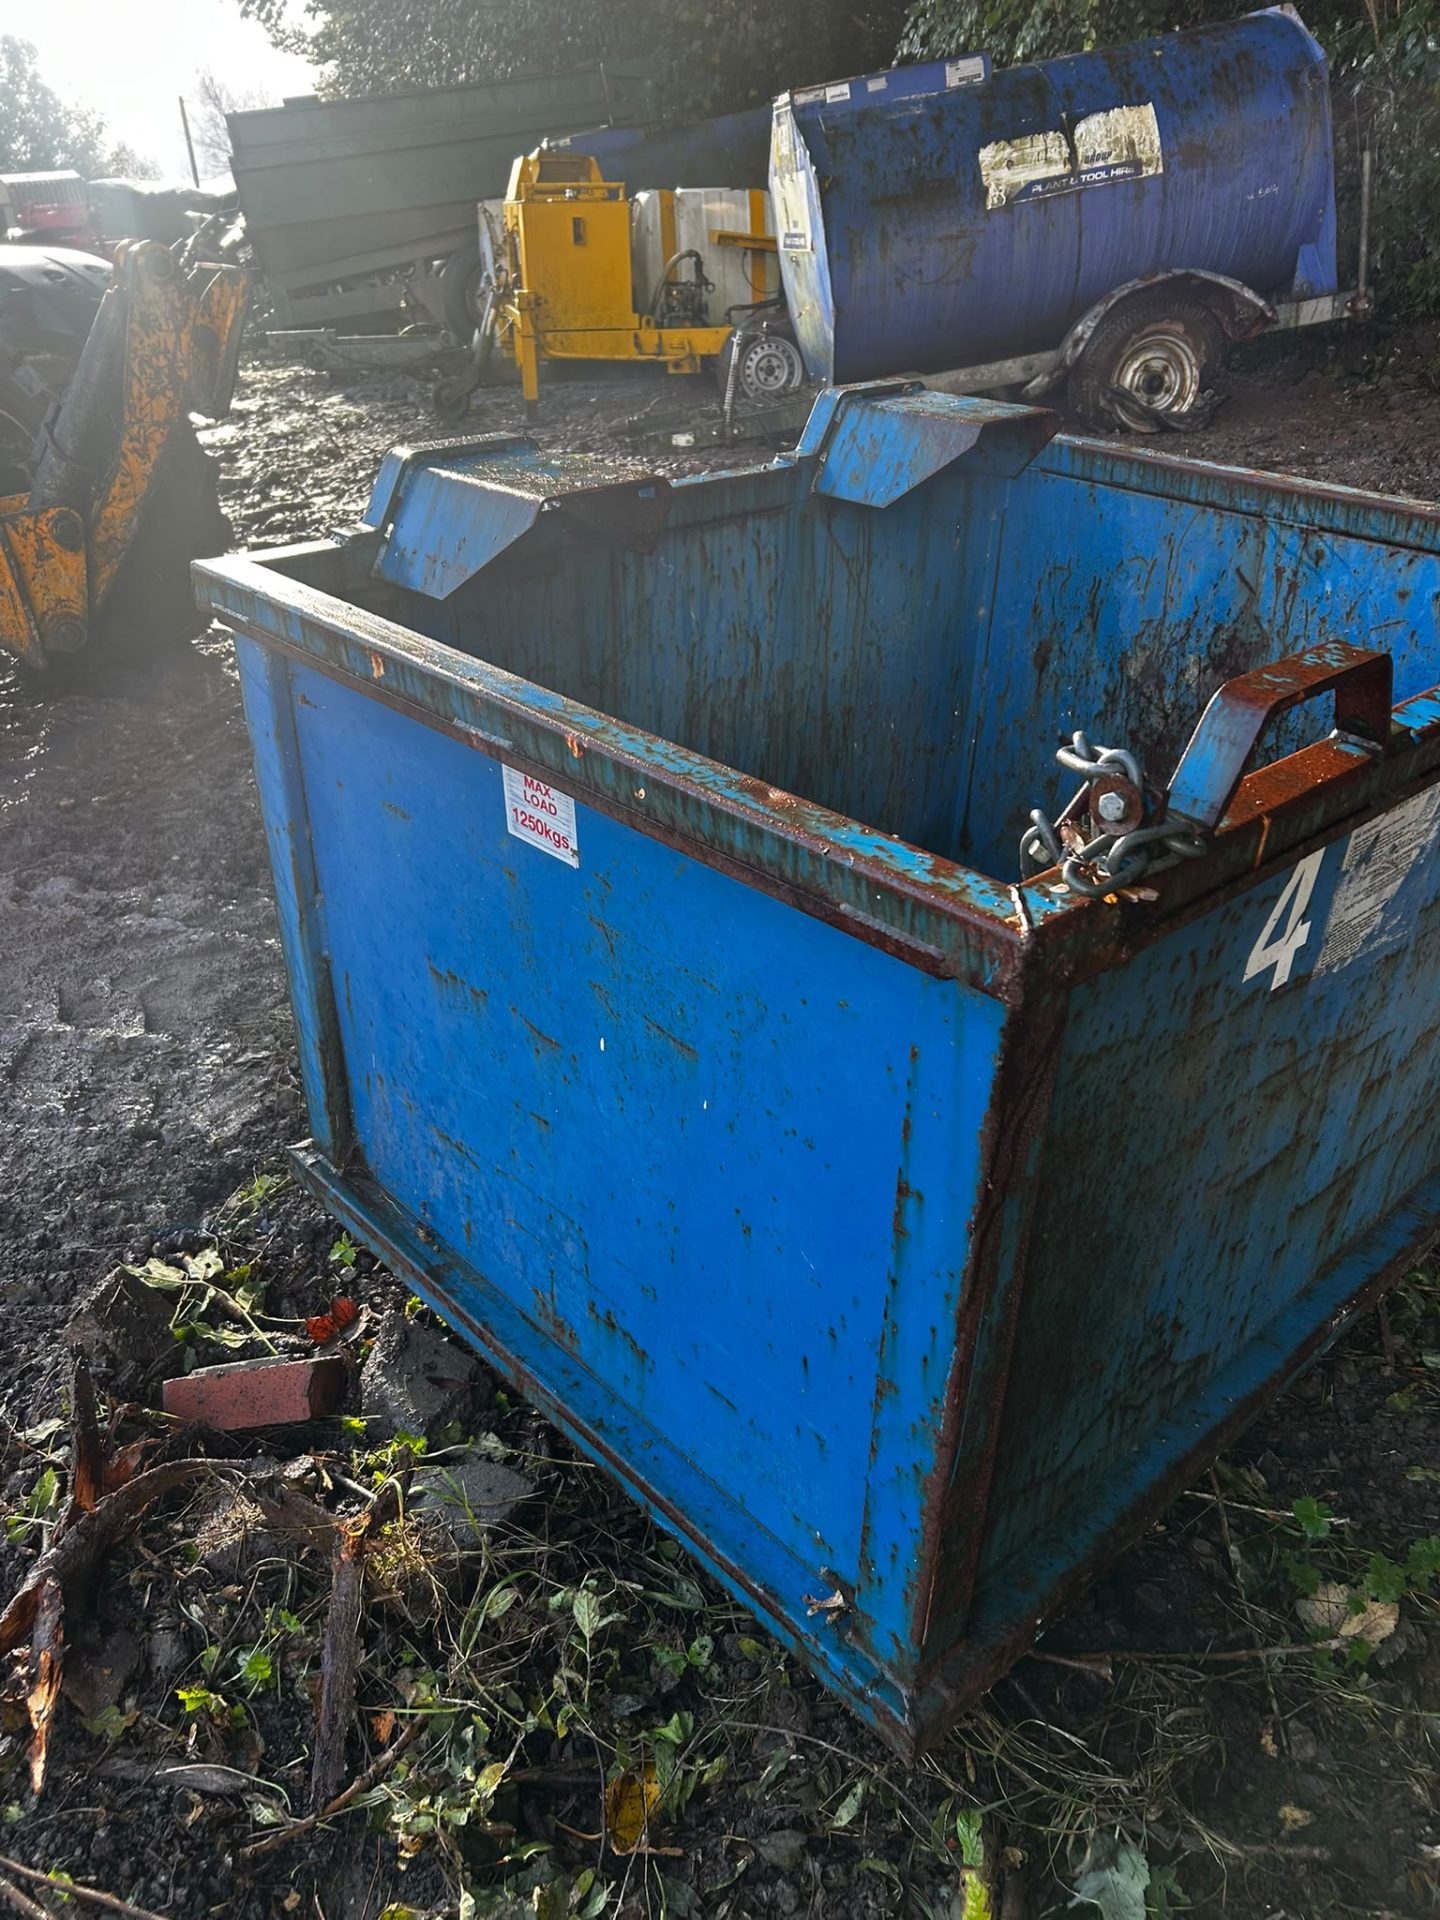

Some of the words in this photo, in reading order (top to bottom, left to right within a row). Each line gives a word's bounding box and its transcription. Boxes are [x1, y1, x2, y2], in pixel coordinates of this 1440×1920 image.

[1032, 179, 1068, 193] PLANT
[1080, 171, 1109, 182] TOOL
[523, 790, 558, 816] LOAD
[1242, 846, 1327, 991] 4
